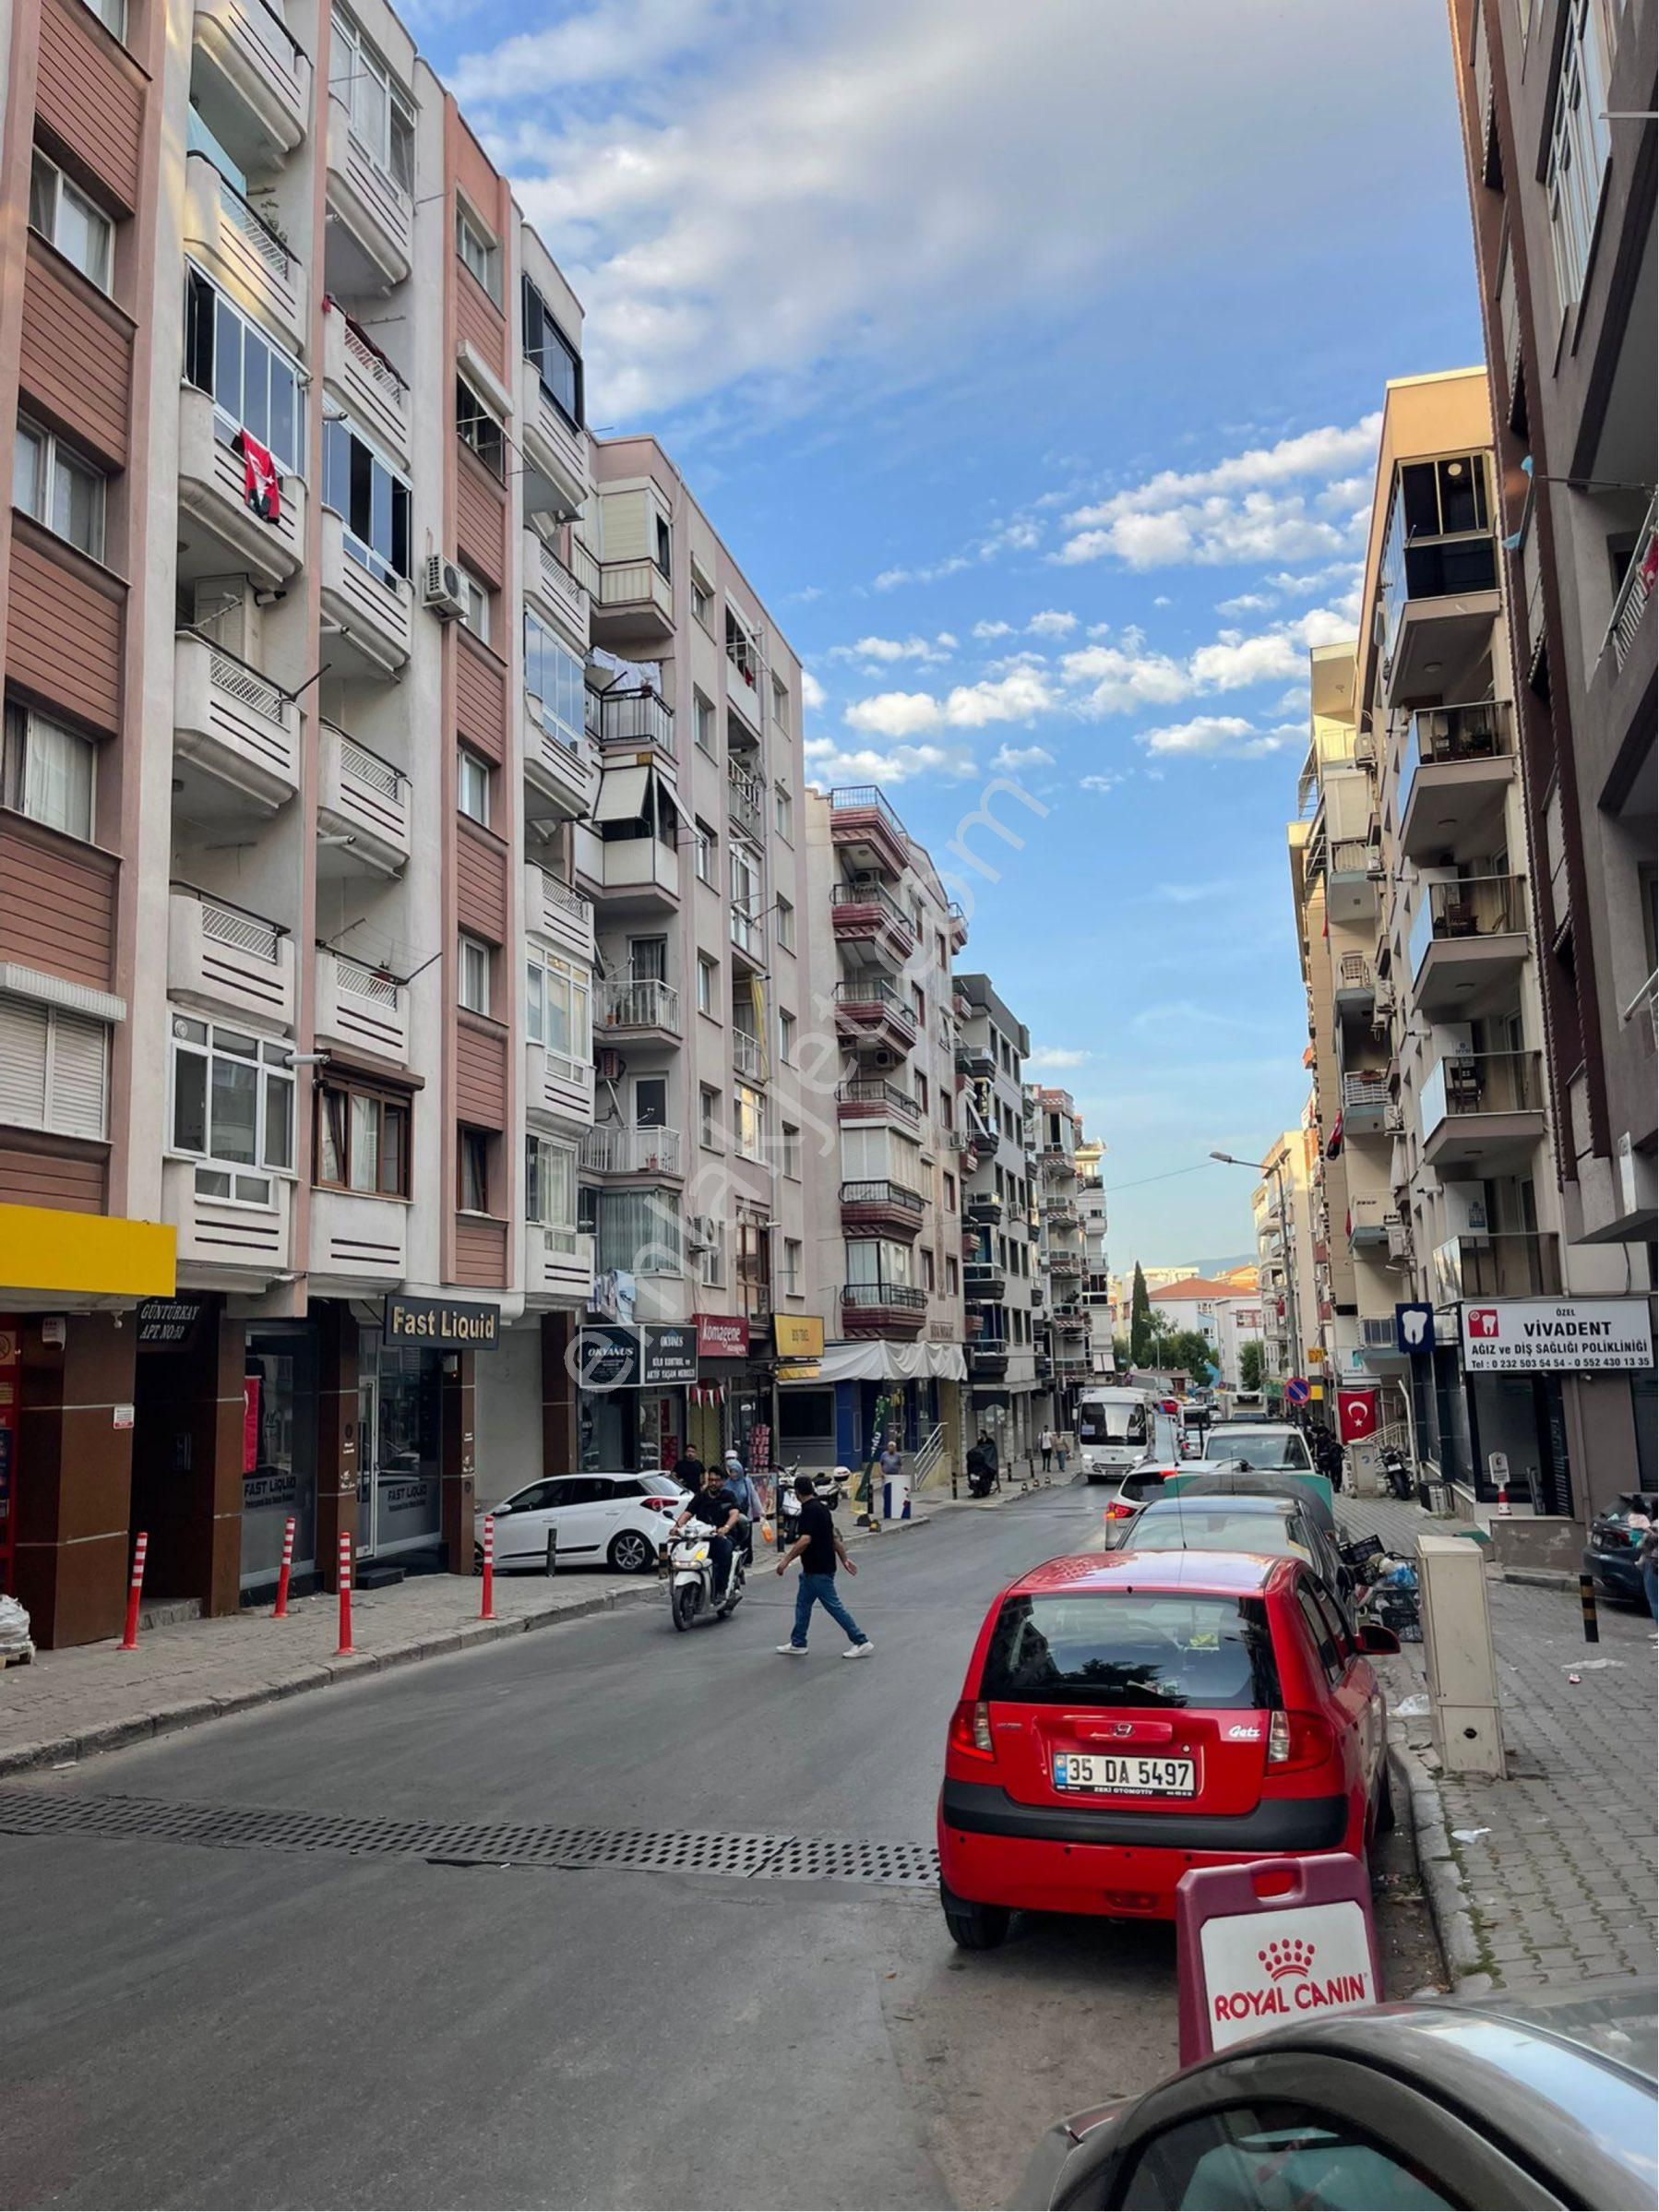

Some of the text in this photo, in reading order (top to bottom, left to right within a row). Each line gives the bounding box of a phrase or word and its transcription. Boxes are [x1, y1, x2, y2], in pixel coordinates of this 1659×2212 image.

[393, 1306, 436, 1335] Fast
[1556, 1308, 1576, 1316] ÖZEL
[1523, 1319, 1612, 1337] VİVADENT
[587, 1347, 635, 1357] OKYANUS
[1472, 1339, 1648, 1357] AĞIZ ve DİŞ SAĞLIĞI POLİKLİNİĞİ
[1492, 1360, 1498, 1369] 0
[1500, 1359, 1518, 1368] 232
[1520, 1359, 1537, 1368] 503
[1540, 1359, 1551, 1368] 54
[1554, 1359, 1565, 1368] 54
[1575, 1358, 1581, 1367] 0
[1583, 1357, 1601, 1367] 552
[1603, 1357, 1621, 1367] 430
[1624, 1357, 1635, 1366] 13
[1638, 1357, 1650, 1366] 35
[245, 1480, 268, 1496] FAST
[1228, 1725, 1260, 1739] Getz
[1068, 1758, 1189, 1788] 35 DA 5497
[1214, 1973, 1366, 2022] ROYAL CANIN
